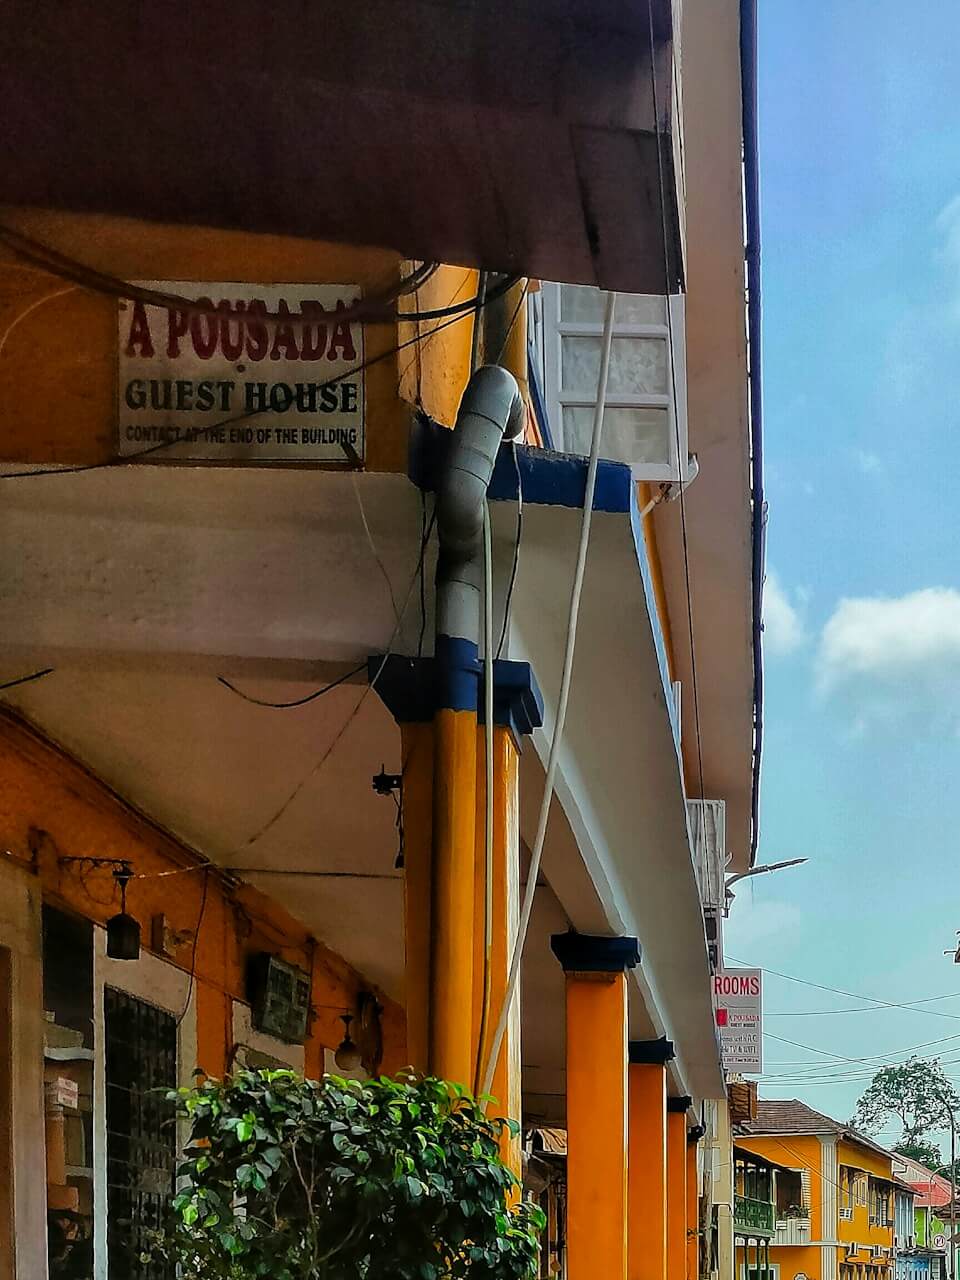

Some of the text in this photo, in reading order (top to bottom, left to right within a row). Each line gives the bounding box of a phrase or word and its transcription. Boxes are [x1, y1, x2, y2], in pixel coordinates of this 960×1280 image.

[125, 297, 357, 361] A POUSADA
[125, 379, 357, 413] GUEST HOUSE
[126, 426, 183, 443] CONTACT
[203, 428, 225, 444] THE
[229, 428, 253, 444] END
[256, 429, 271, 444] OF
[275, 429, 298, 444] THE
[302, 429, 357, 444] BUILDING
[714, 976, 759, 995] ROOMS
